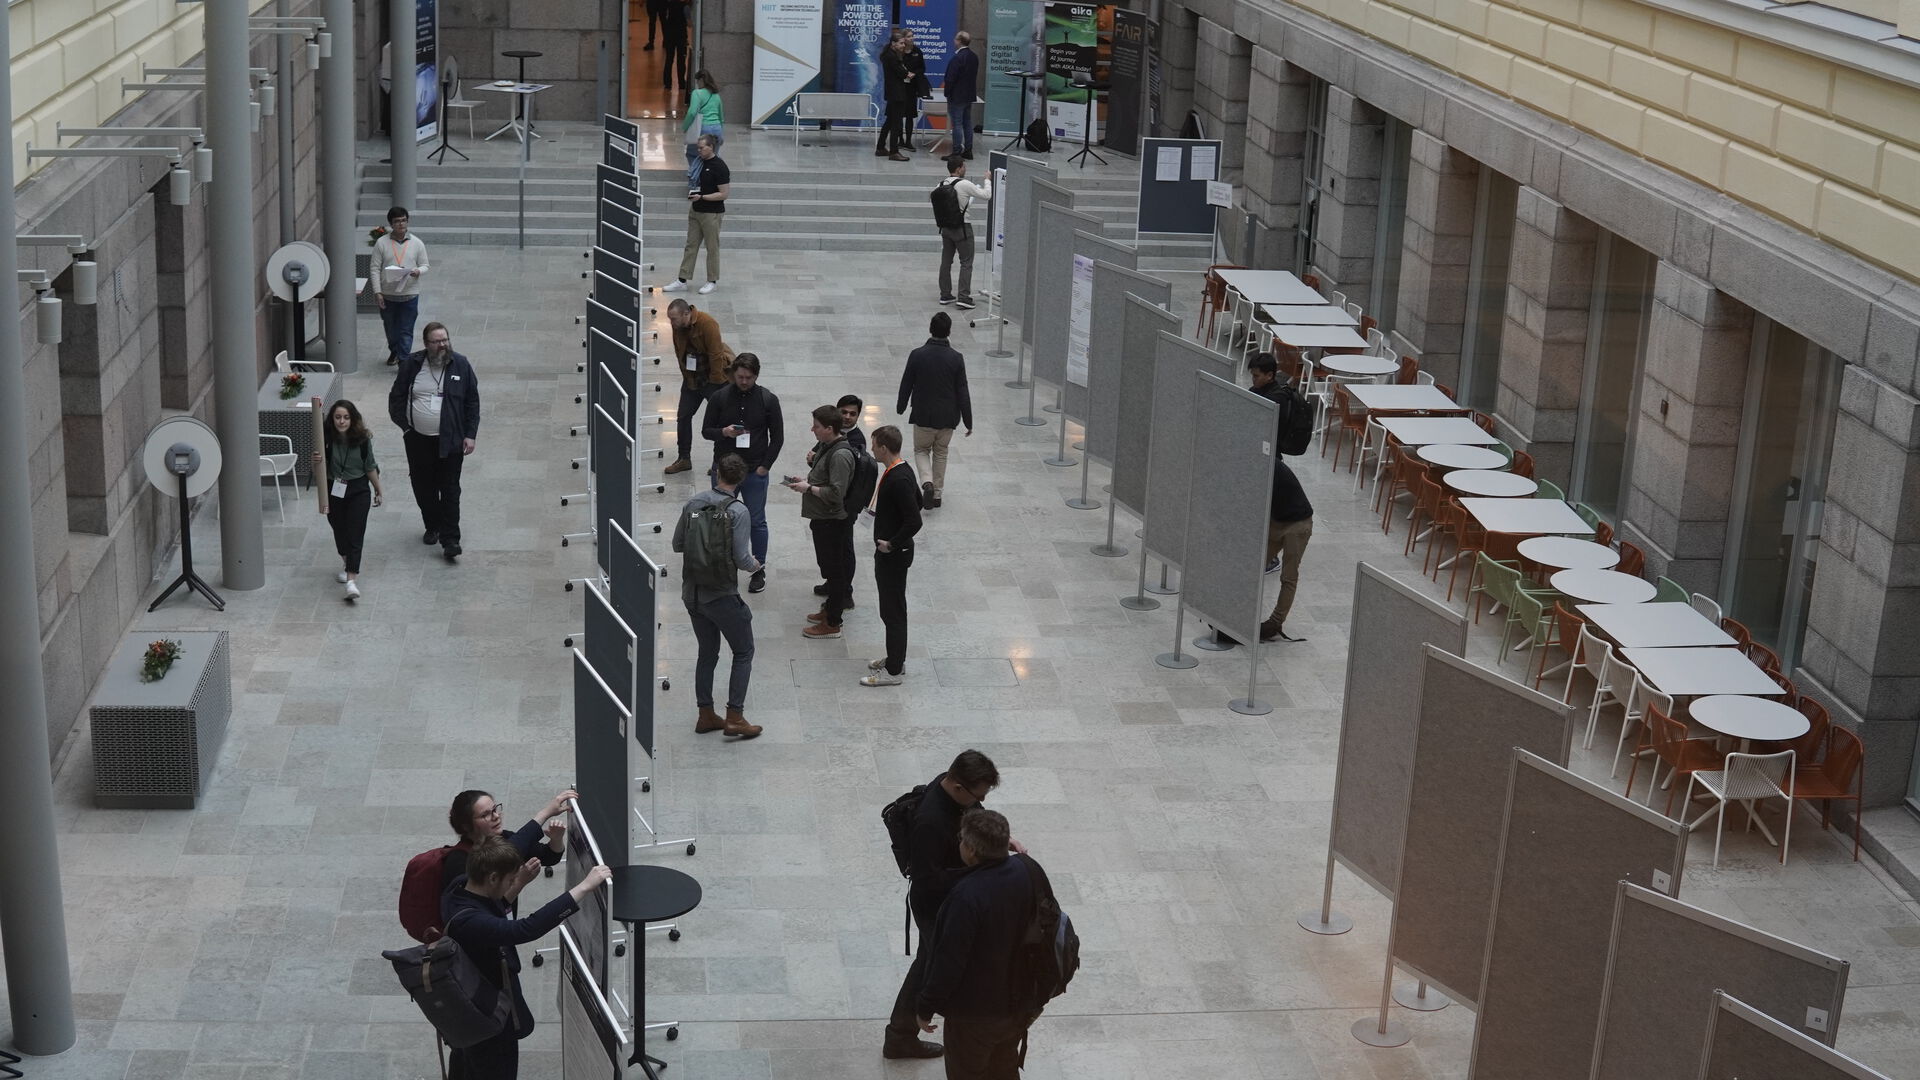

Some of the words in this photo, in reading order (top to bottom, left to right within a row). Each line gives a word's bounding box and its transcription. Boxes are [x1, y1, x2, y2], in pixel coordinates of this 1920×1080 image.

[845, 4, 866, 12] WITH
[867, 4, 883, 12] THE
[1070, 6, 1093, 16] aika
[842, 12, 872, 20] POWER
[873, 12, 885, 20] OF
[838, 19, 889, 28] KNOWLEDGE
[917, 19, 931, 27] help
[849, 27, 866, 35] FOR
[867, 27, 883, 35] THE
[1114, 22, 1142, 41] FAIR
[848, 34, 878, 43] WORLD
[922, 40, 947, 48] through
[991, 44, 1020, 53] creating
[1049, 47, 1064, 55] Begin
[990, 58, 1027, 66] healthcare
